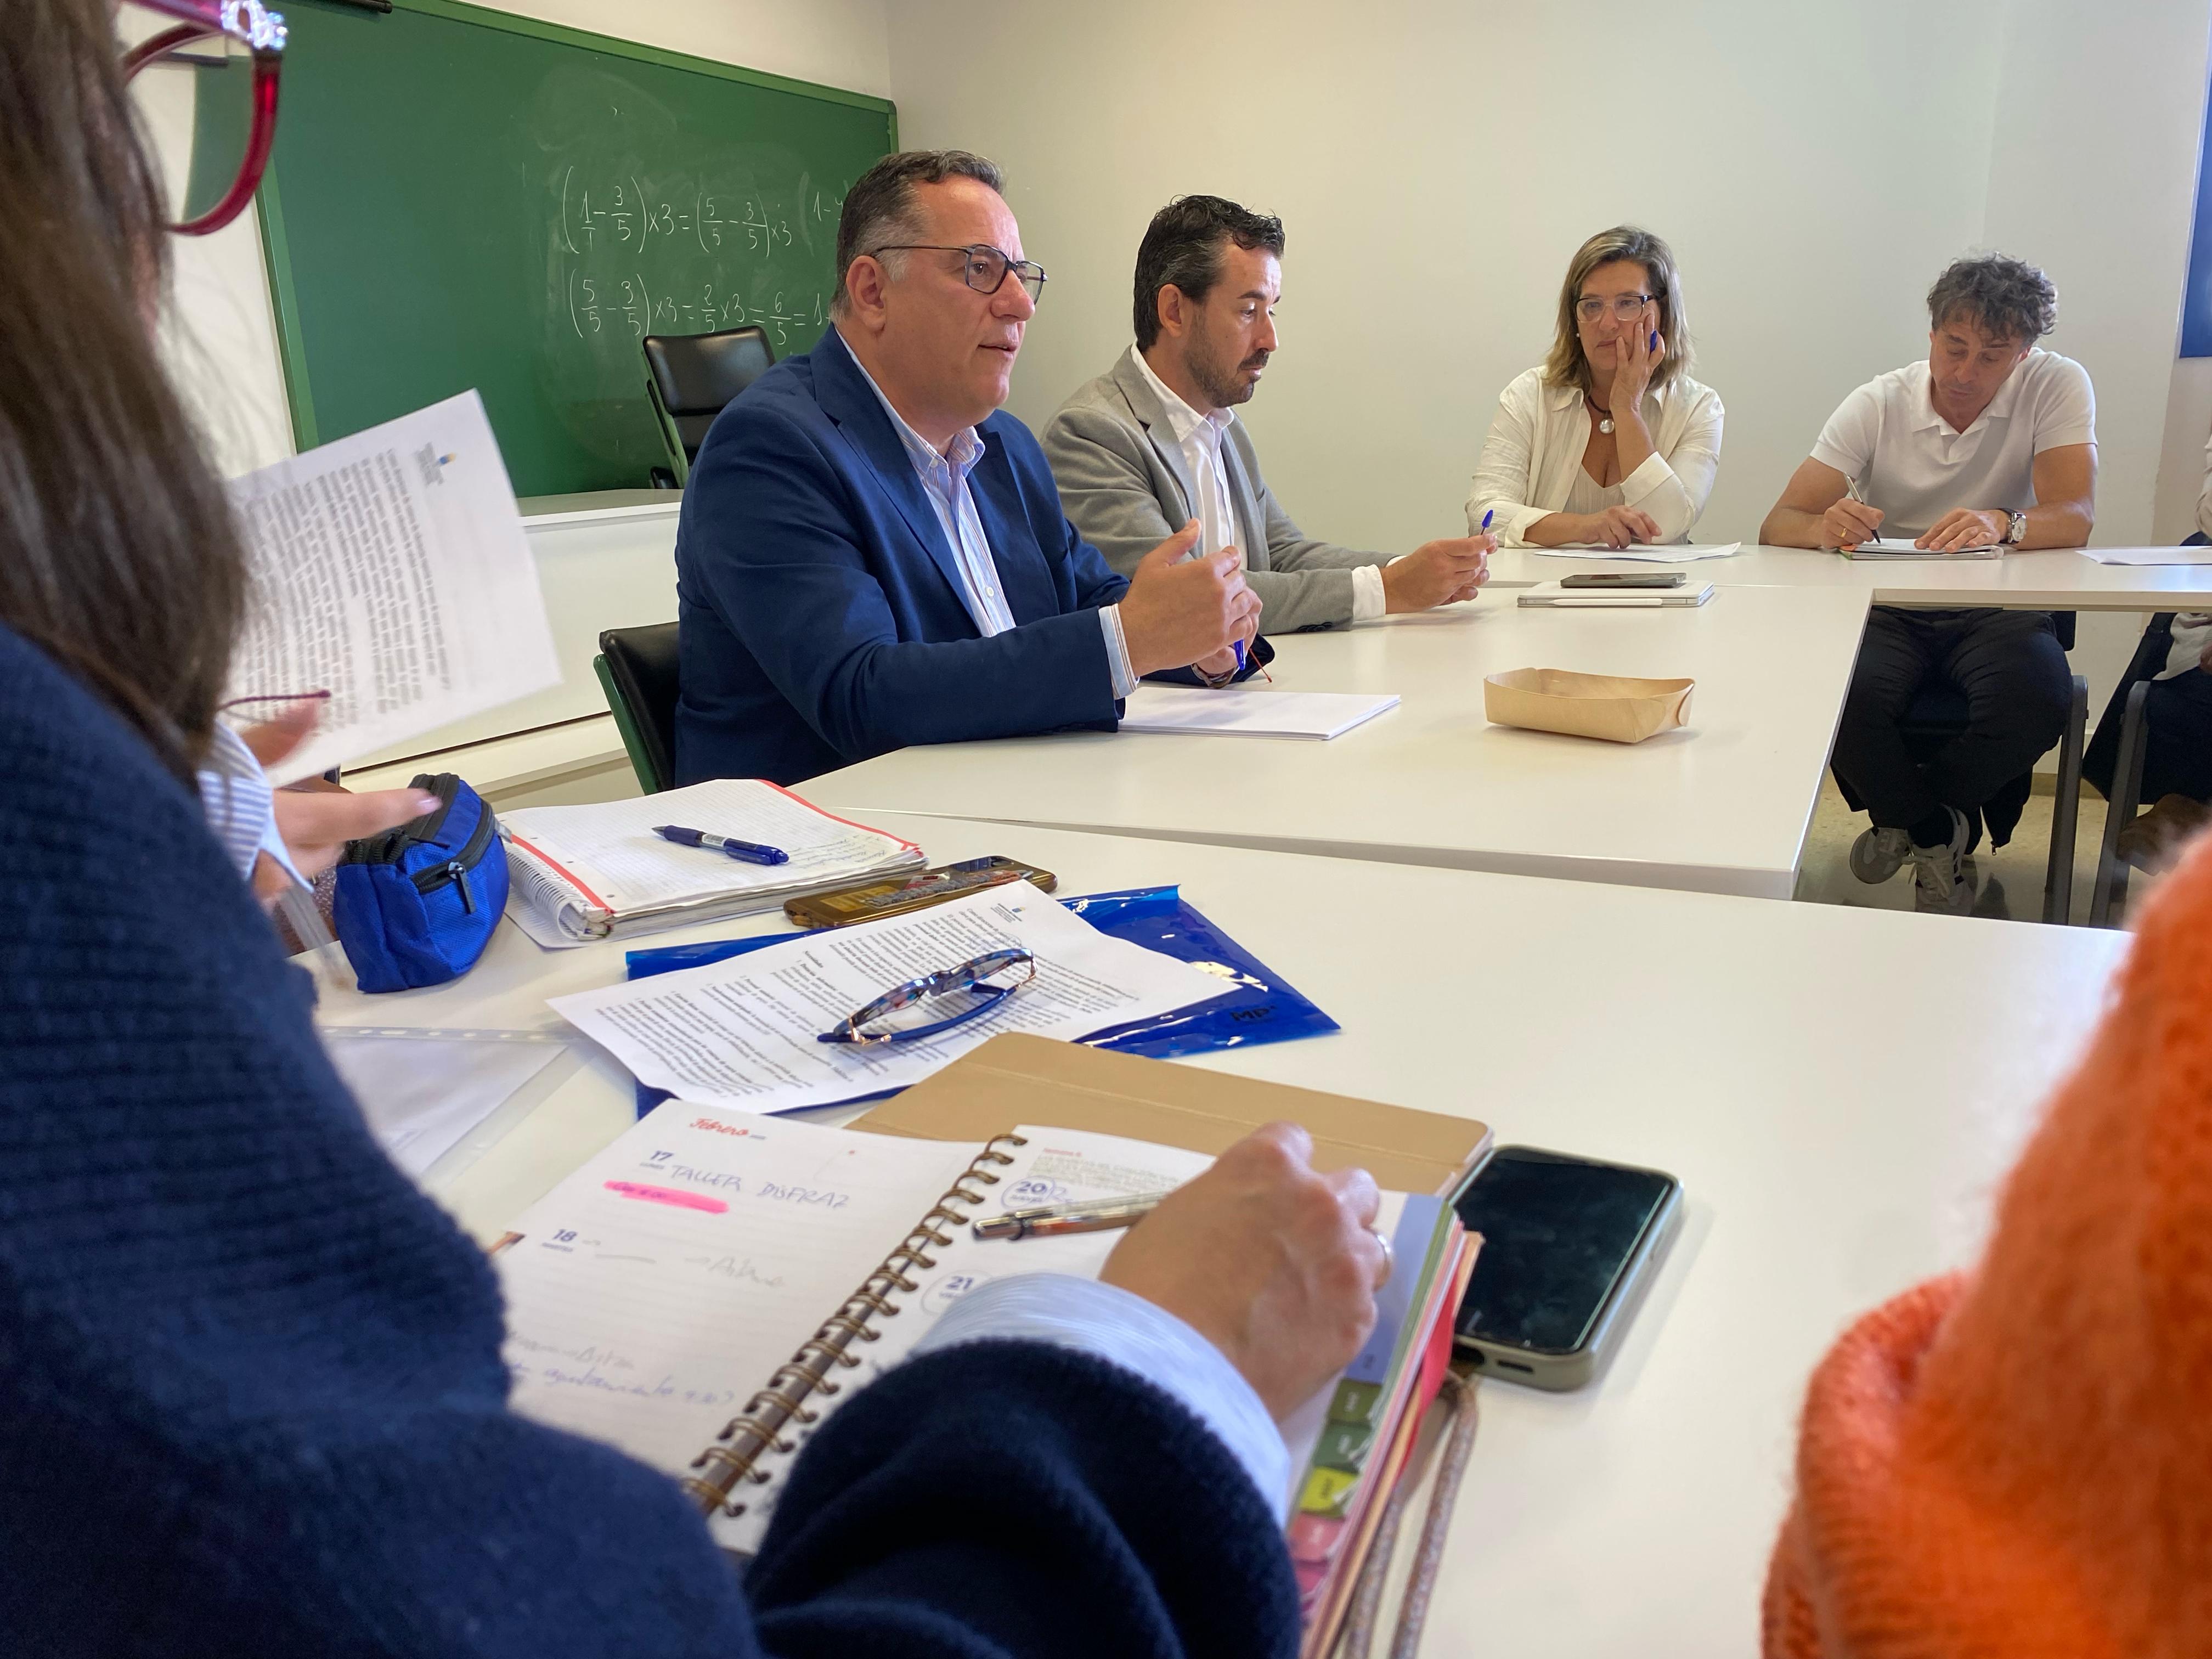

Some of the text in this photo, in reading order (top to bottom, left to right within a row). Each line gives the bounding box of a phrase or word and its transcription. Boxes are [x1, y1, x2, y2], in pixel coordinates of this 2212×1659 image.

[689, 1118, 749, 1136] Febrero
[649, 1150, 674, 1161] 17
[668, 1164, 742, 1192] TALLER
[1016, 1181, 1047, 1193] 20
[552, 1229, 578, 1242] 18
[946, 1276, 975, 1290] 21
